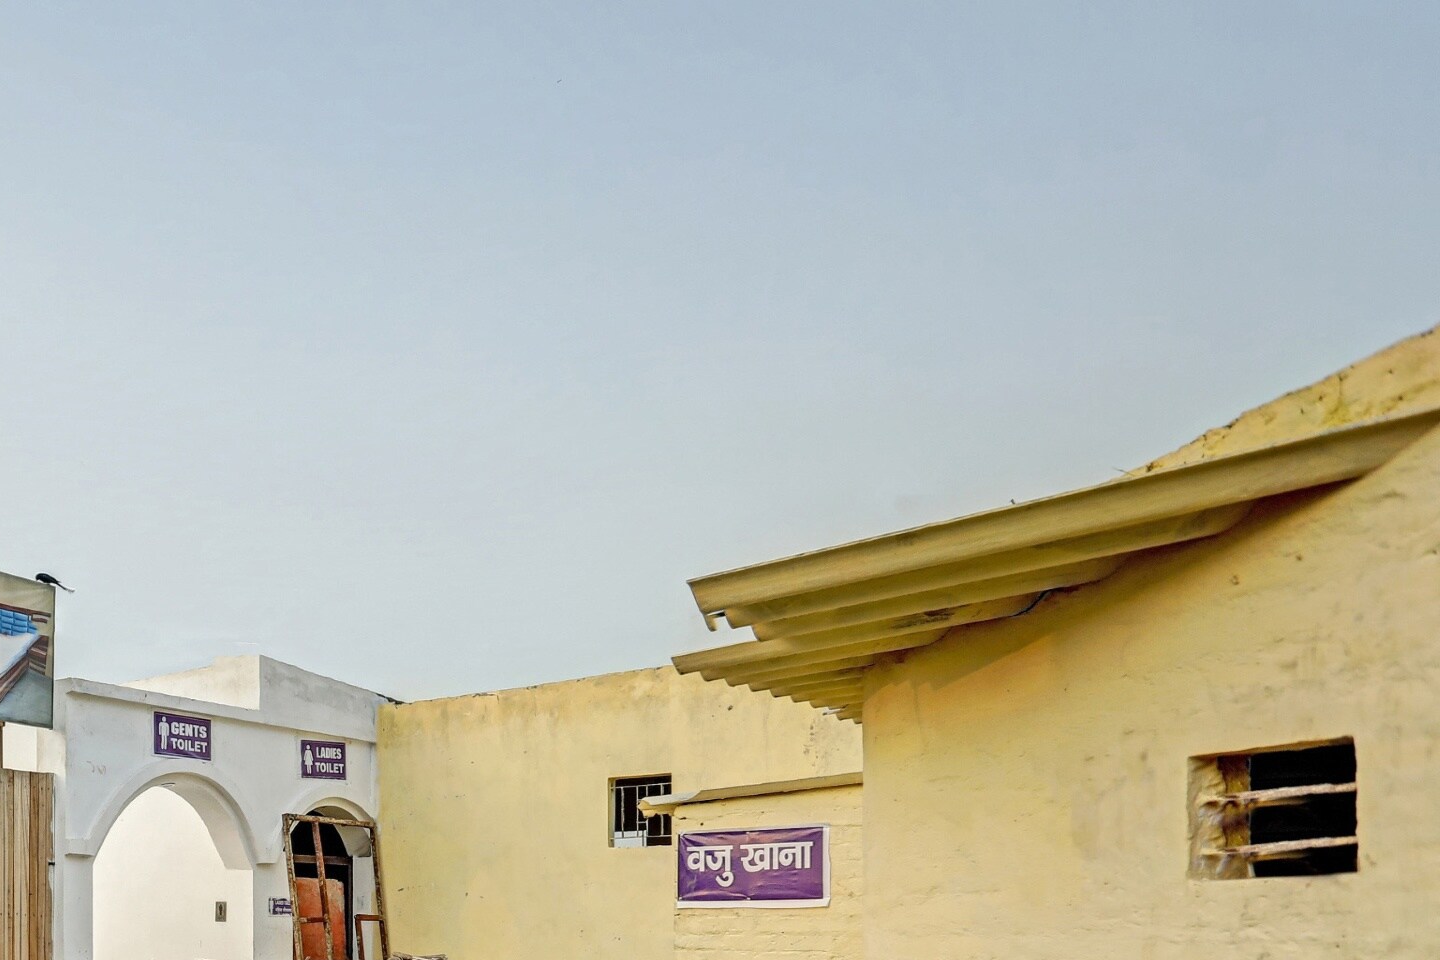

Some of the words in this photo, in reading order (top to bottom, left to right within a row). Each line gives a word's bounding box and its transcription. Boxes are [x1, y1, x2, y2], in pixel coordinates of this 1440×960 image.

[170, 721, 207, 739] GENTS
[170, 737, 208, 753] TOILET
[316, 746, 342, 760] LADIES
[314, 761, 345, 774] TOILET
[686, 844, 735, 888] वजु
[739, 840, 814, 873] खाना
